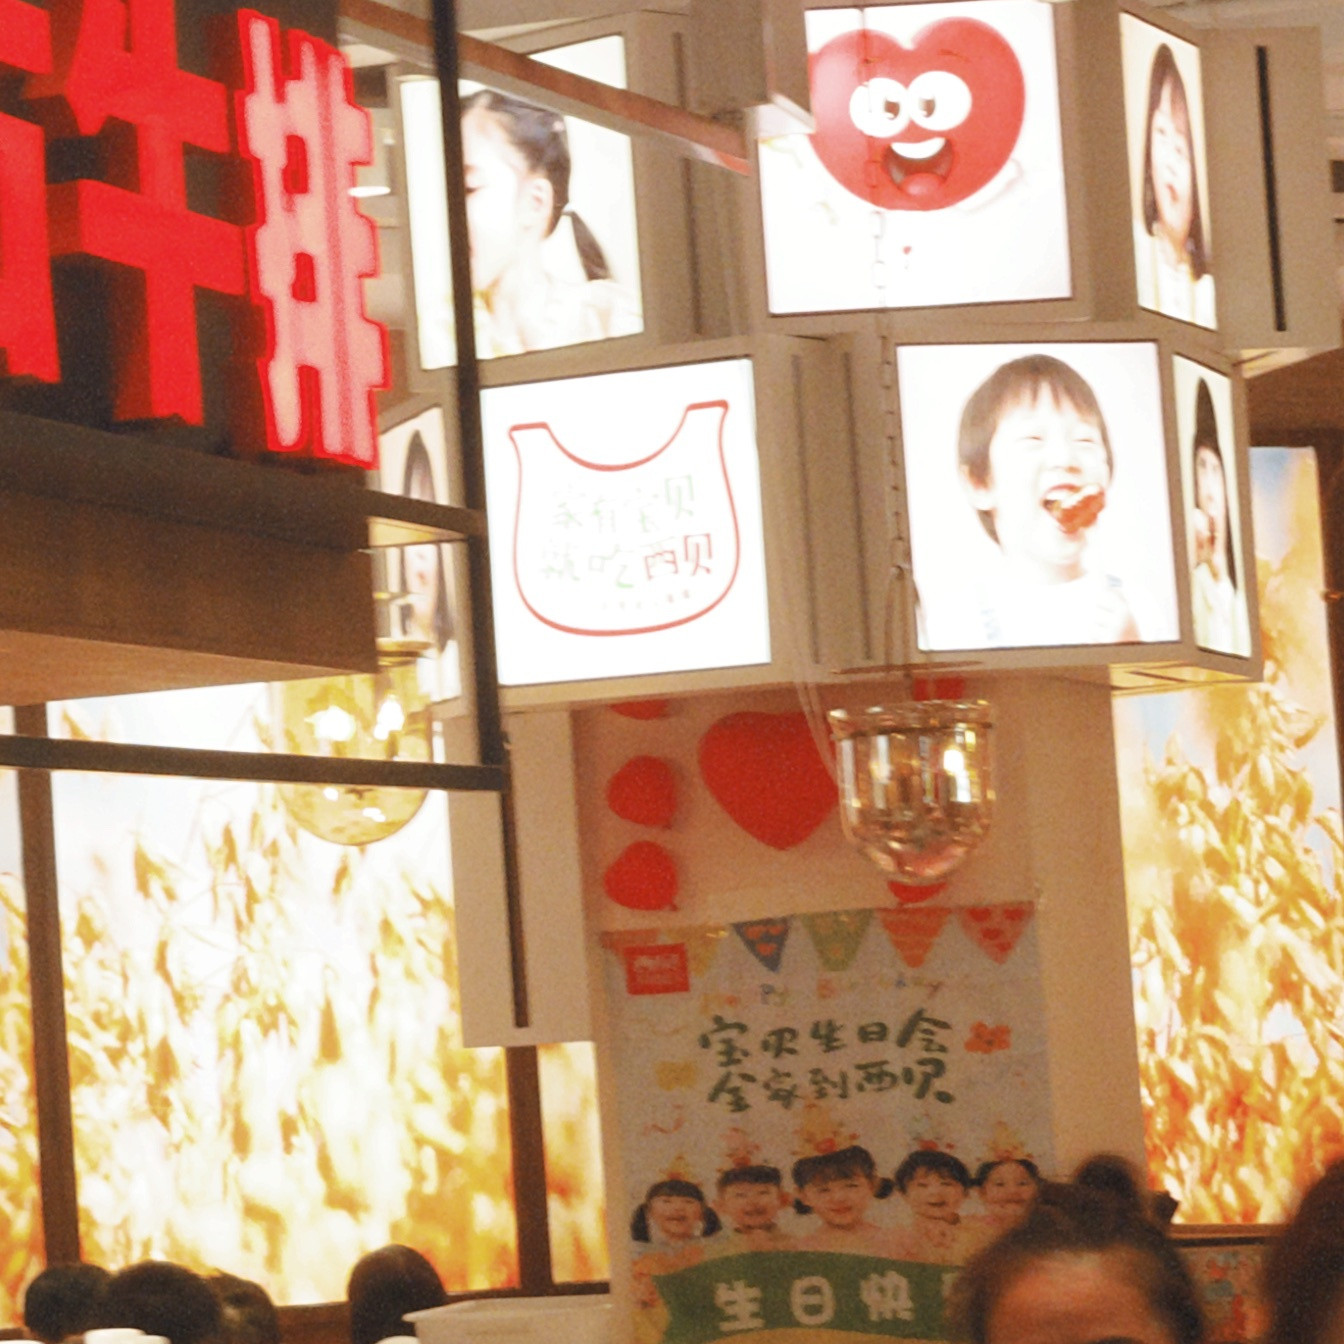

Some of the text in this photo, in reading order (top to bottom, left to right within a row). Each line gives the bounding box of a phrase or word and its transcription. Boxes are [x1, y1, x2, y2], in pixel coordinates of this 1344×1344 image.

[698, 1007, 953, 1068] 宝贝生日会
[713, 1269, 962, 1334] 生日快
